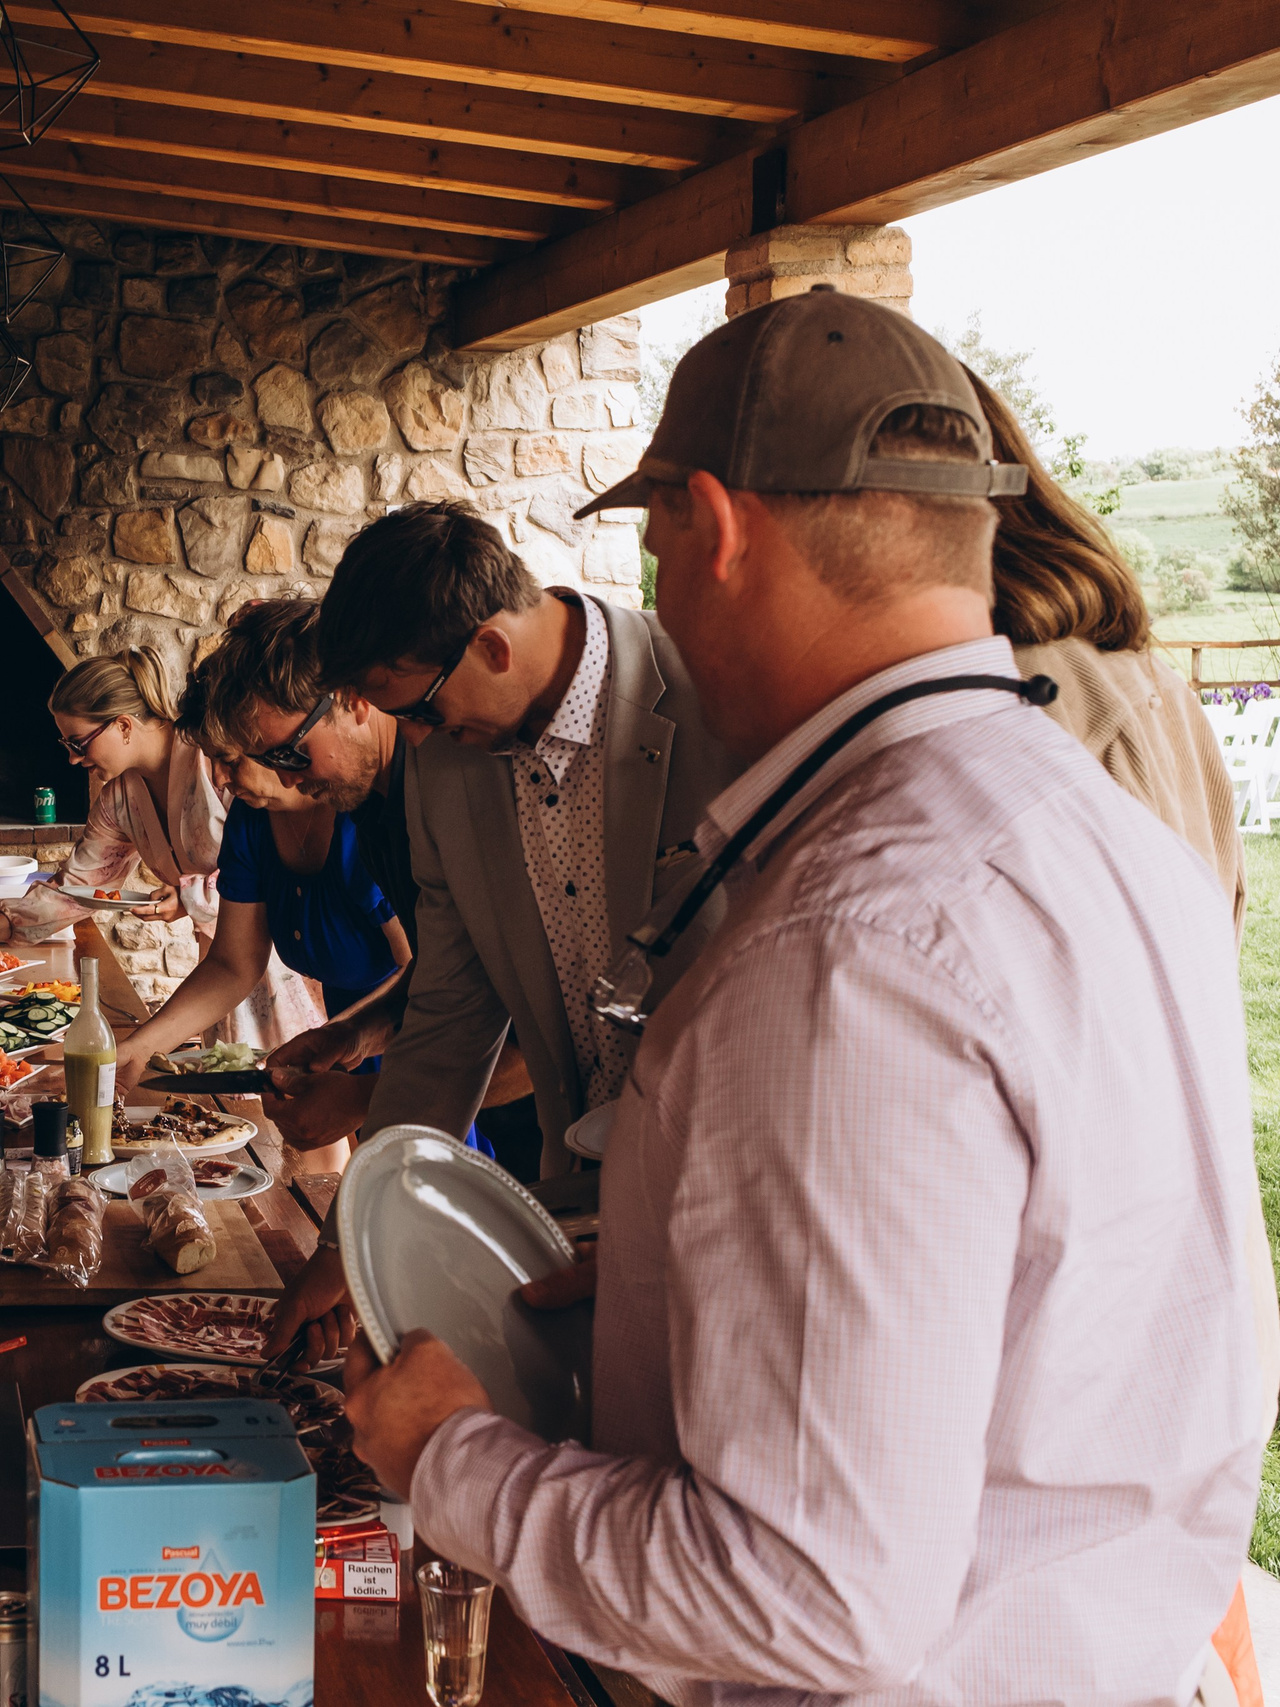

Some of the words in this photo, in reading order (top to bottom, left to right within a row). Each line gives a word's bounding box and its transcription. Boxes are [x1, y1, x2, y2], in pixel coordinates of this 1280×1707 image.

[94, 1463, 231, 1480] BEZOYA
[163, 1546, 198, 1559] Pascual
[348, 1564, 392, 1574] Rauchen
[364, 1576, 376, 1585] ist
[99, 1571, 265, 1611] BEZOYA
[353, 1586, 387, 1595] tödlich
[185, 1620, 209, 1632] muy
[95, 1655, 110, 1677] 8
[119, 1655, 131, 1677] L
